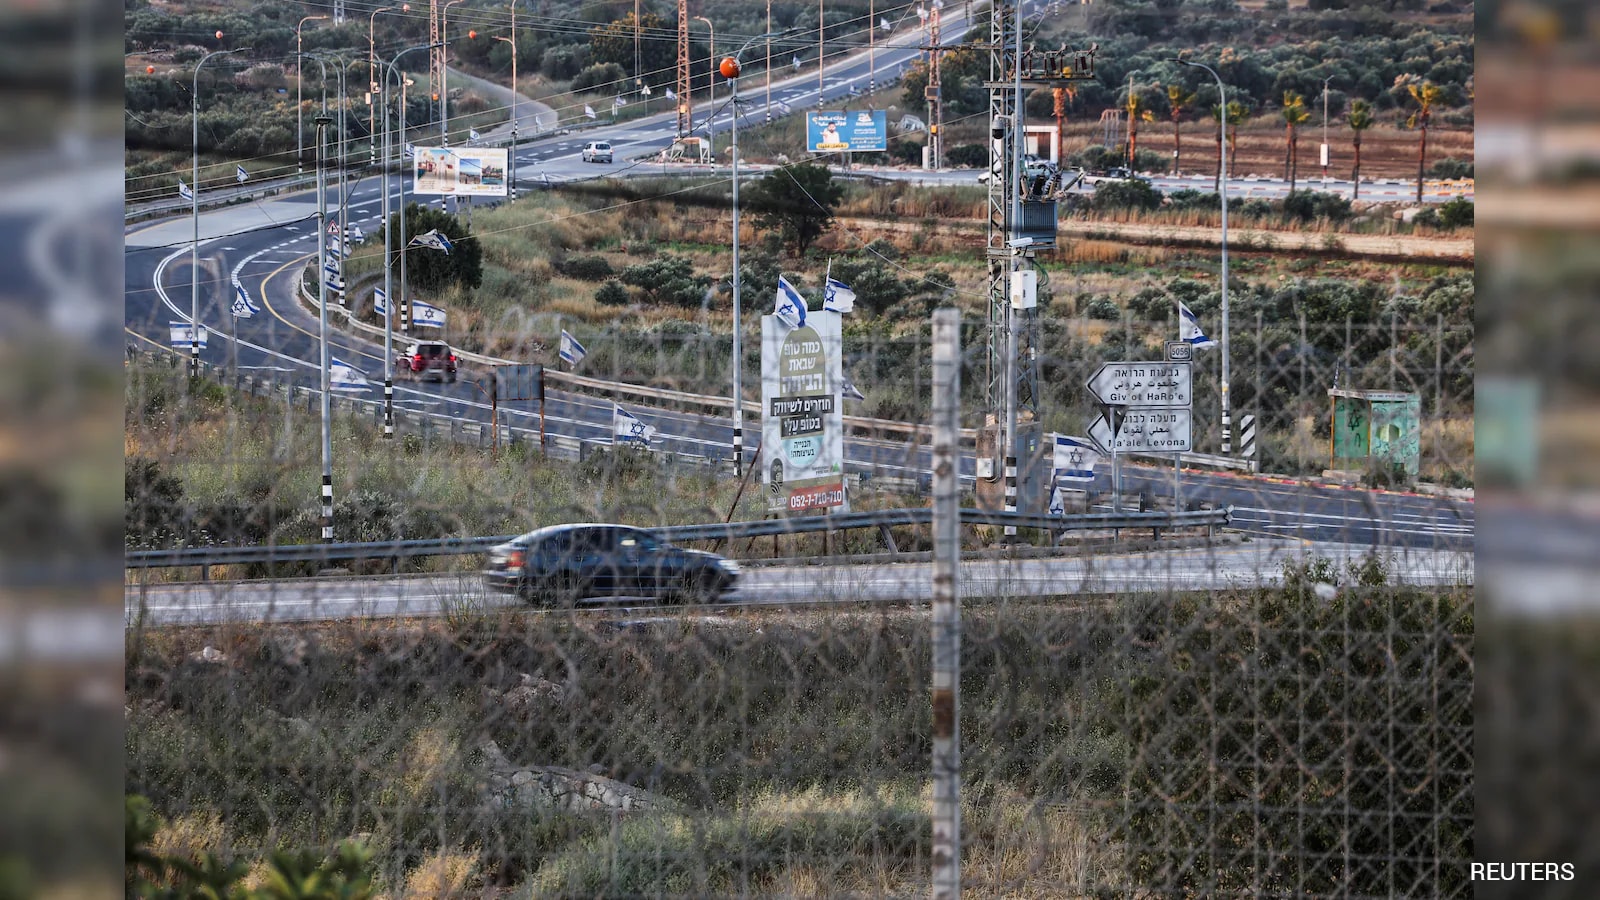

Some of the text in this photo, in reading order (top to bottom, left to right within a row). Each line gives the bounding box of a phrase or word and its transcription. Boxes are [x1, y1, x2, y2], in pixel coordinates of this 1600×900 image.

[802, 341, 820, 354] כמה
[789, 357, 816, 371] שבאת
[1115, 369, 1145, 378] הרואה
[1147, 392, 1184, 401] HaRo'e
[774, 398, 831, 416] חוזרים לשיווק
[1123, 414, 1176, 423] מעלה לבונ
[1147, 439, 1185, 447] Levona
[790, 490, 842, 508] 052-7-710-710
